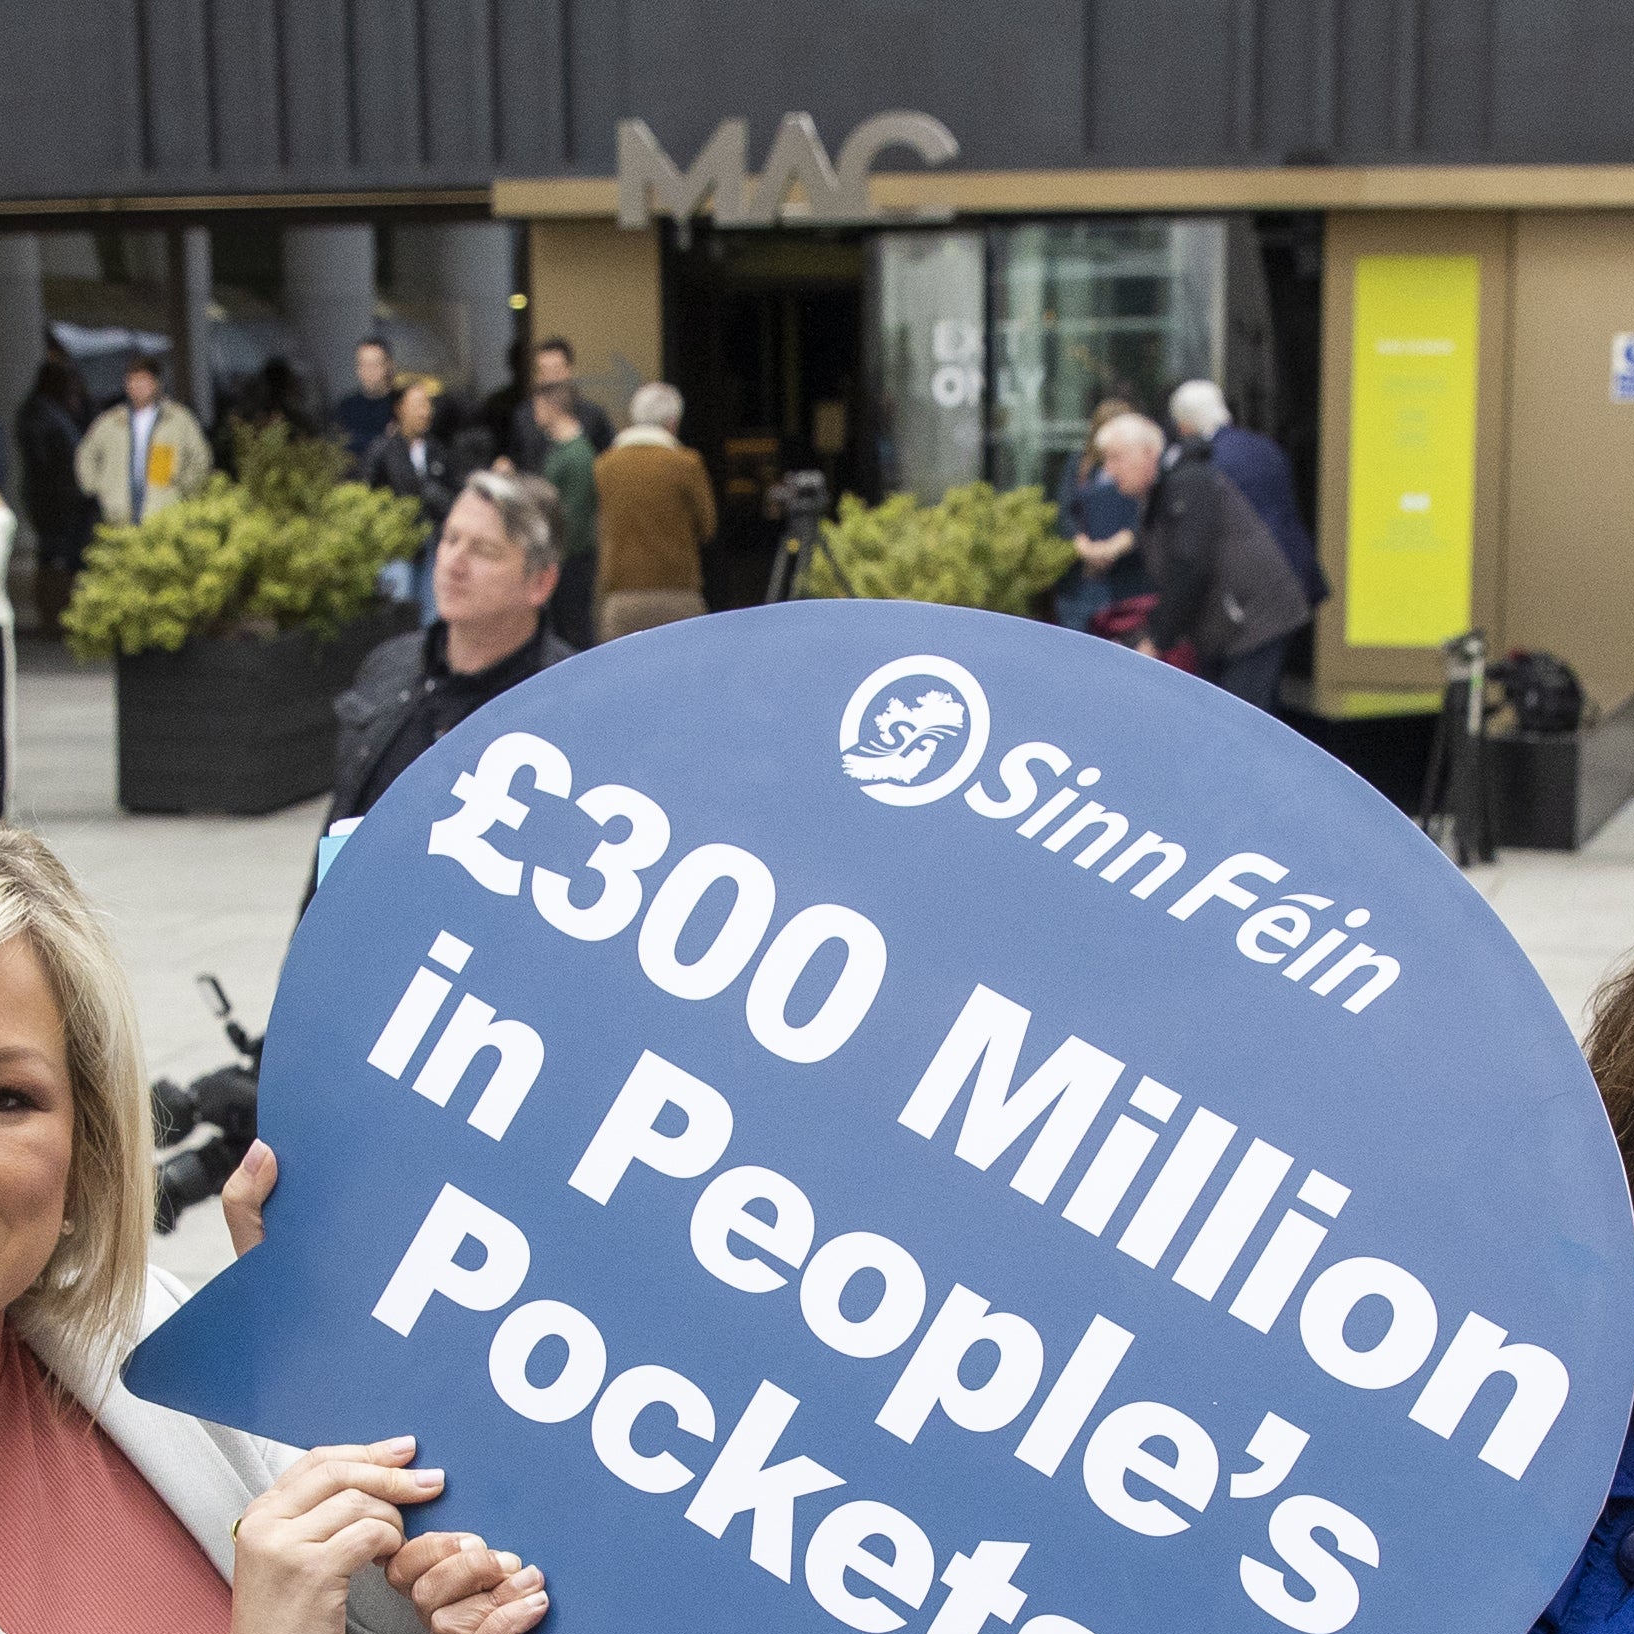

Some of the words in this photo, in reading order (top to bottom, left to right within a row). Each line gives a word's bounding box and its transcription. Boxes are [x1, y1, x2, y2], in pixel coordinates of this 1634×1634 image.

[617, 110, 959, 246] MAC
[427, 732, 887, 1064] £300
[897, 983, 1570, 1481] Million
[964, 741, 1187, 900] Sinn
[1166, 852, 1401, 1014] Féin
[366, 929, 545, 1142] in
[567, 1048, 1380, 1634] People’s
